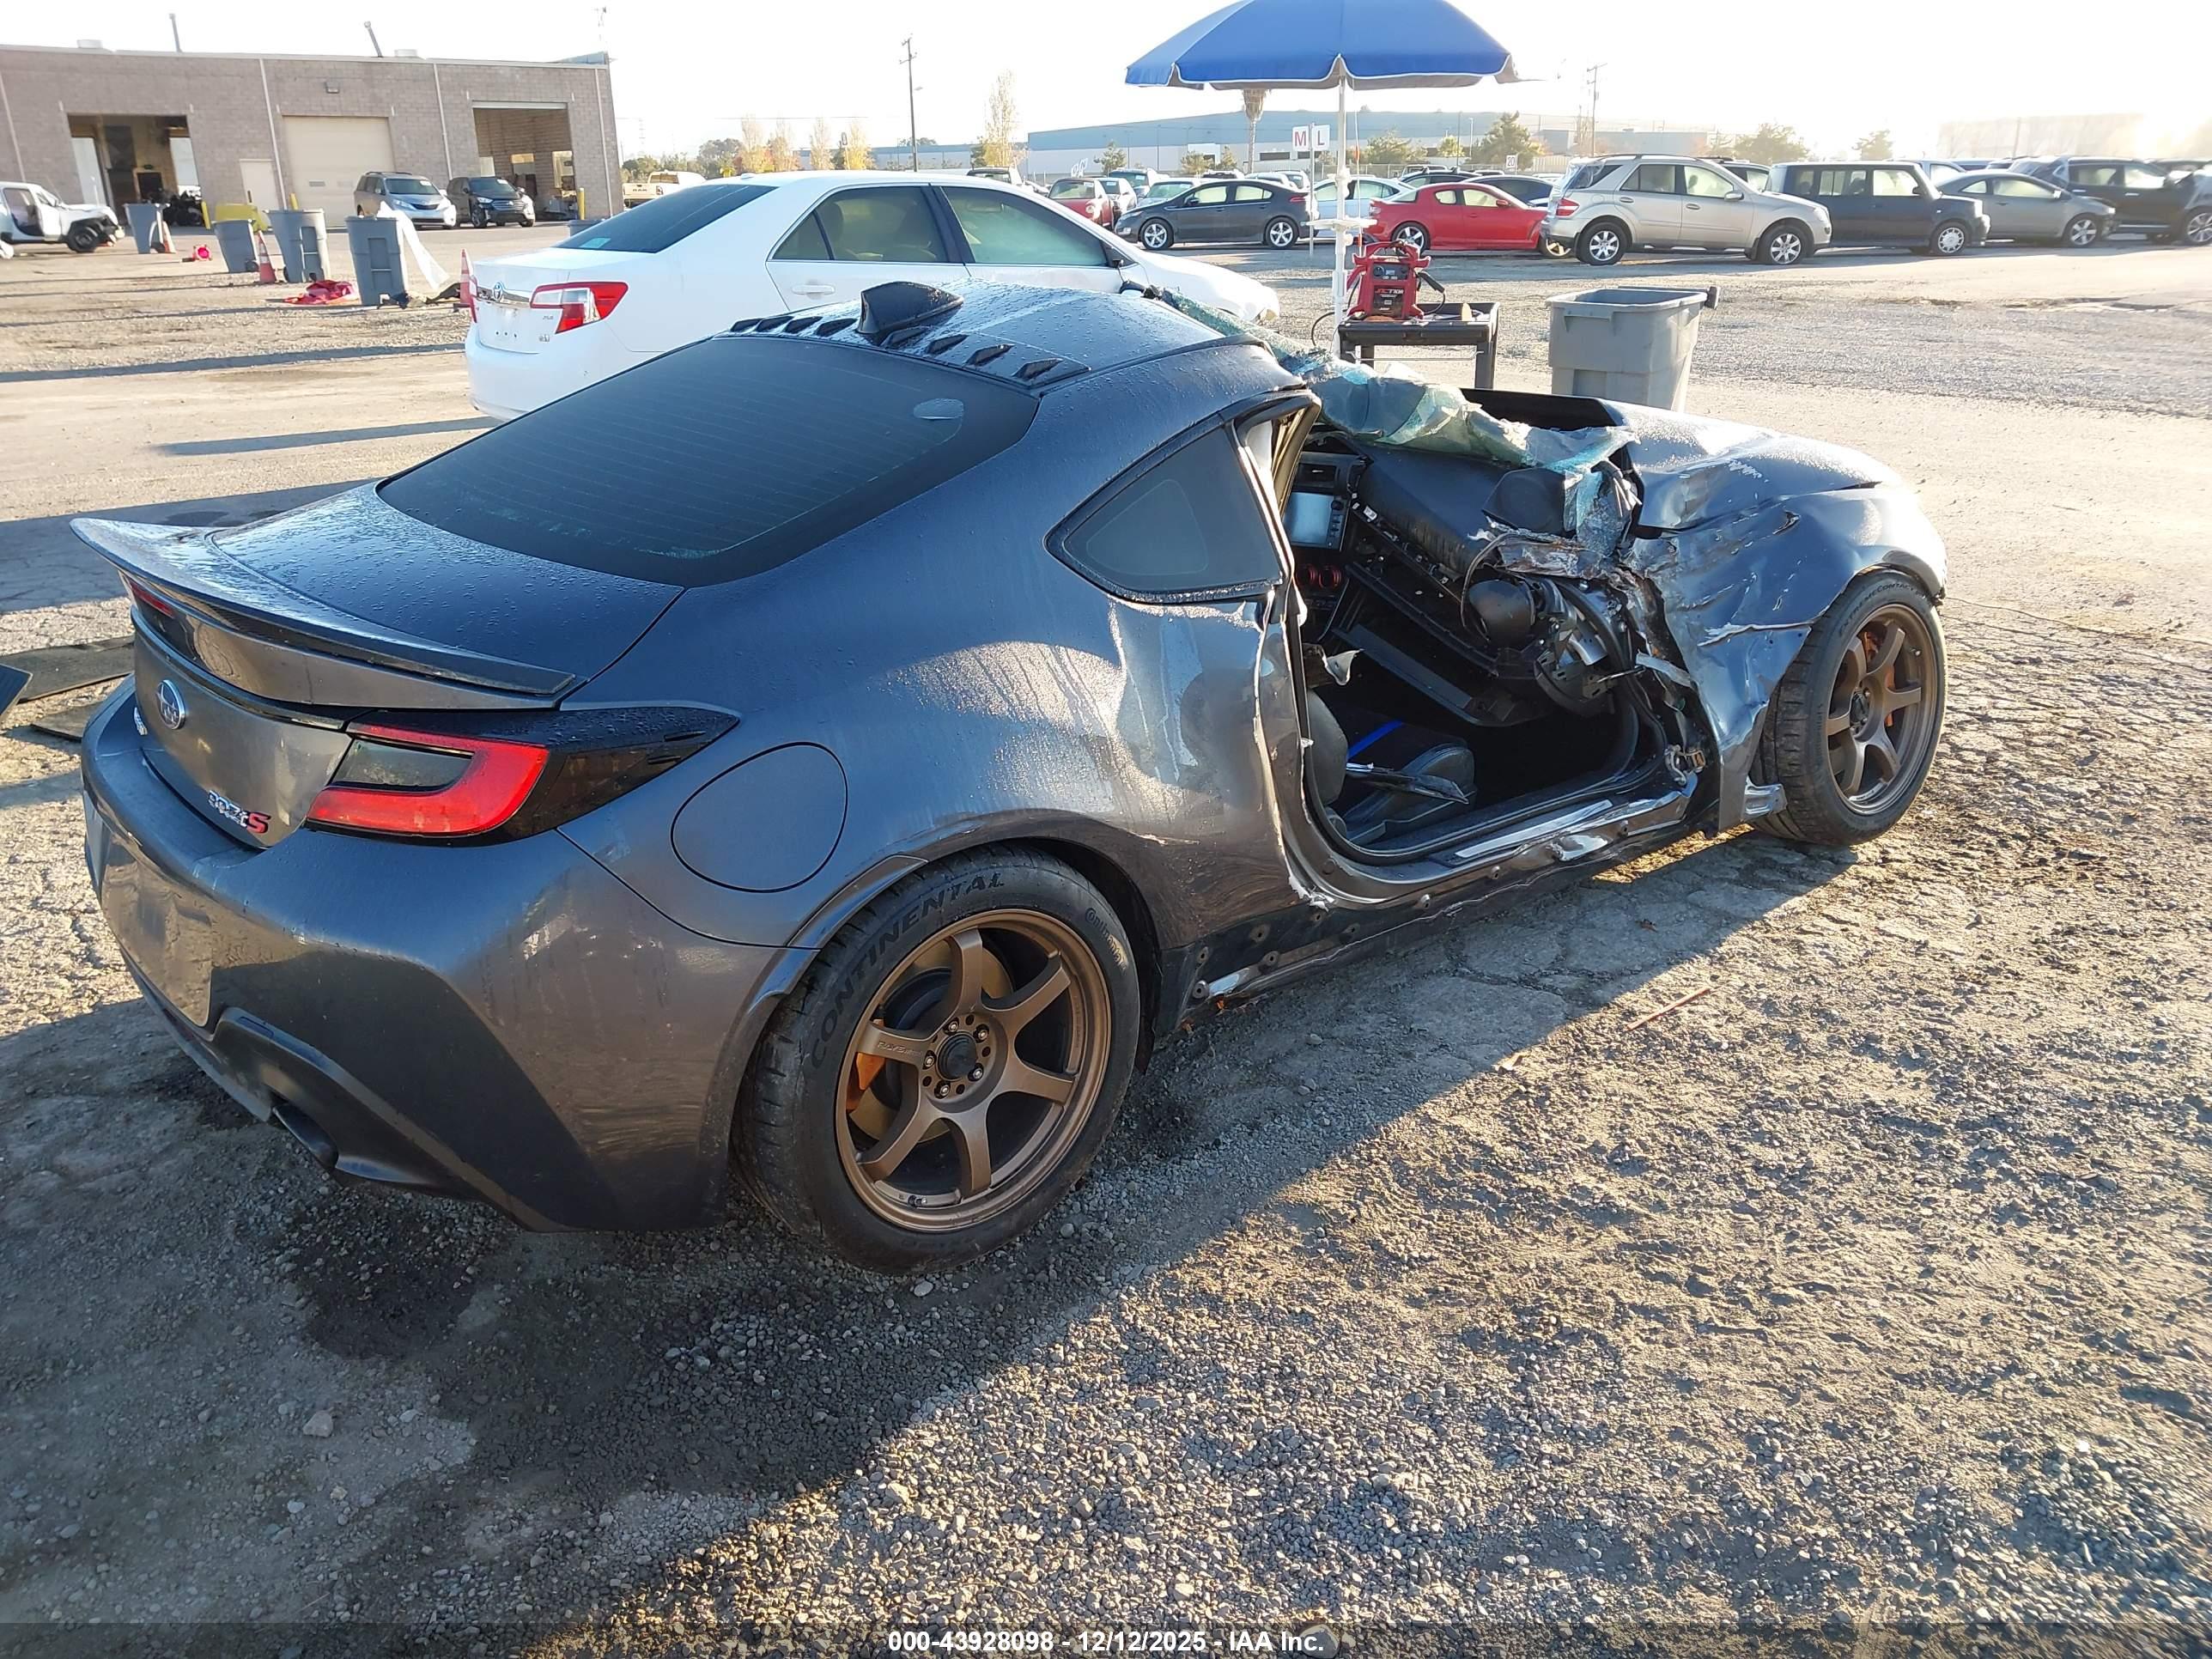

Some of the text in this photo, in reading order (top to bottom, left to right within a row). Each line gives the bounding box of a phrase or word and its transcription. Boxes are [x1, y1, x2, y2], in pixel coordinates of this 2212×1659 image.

[1295, 131, 1306, 147] M
[1317, 131, 1325, 146] L
[1507, 156, 1516, 167] 20
